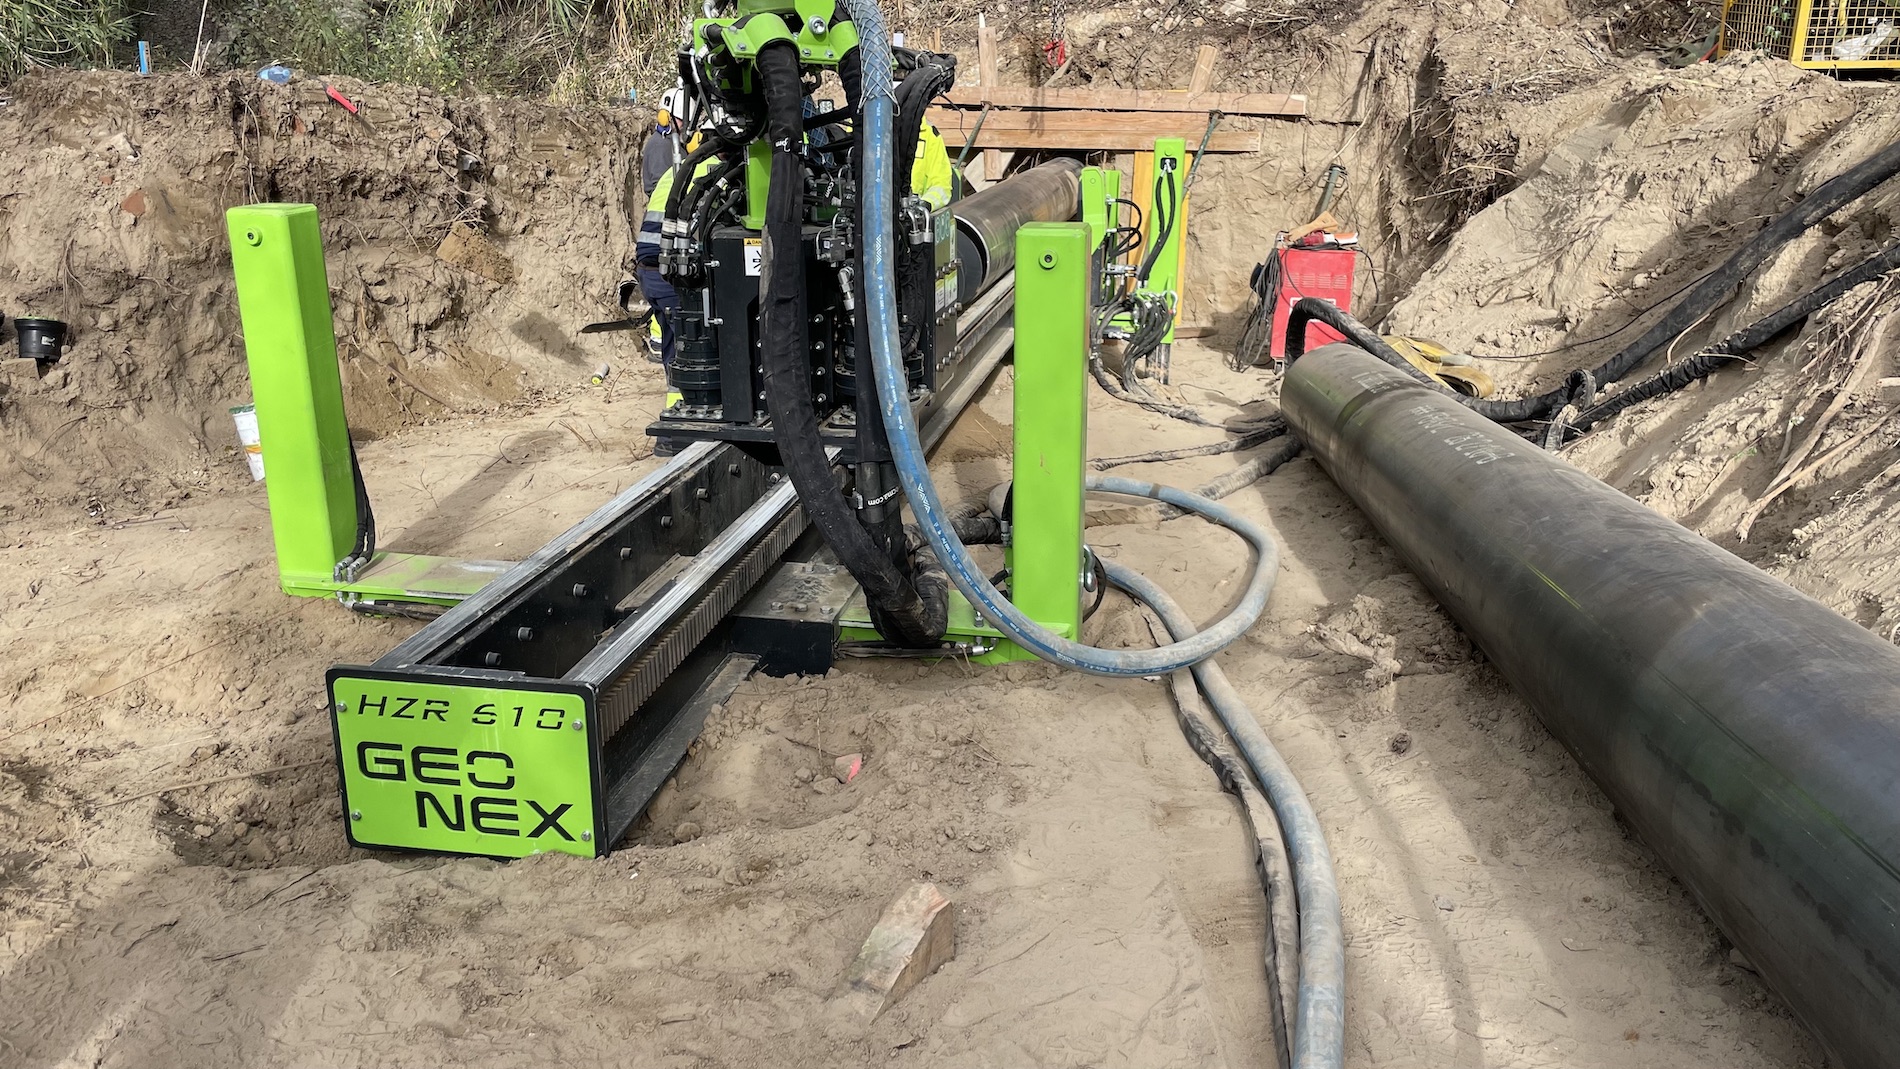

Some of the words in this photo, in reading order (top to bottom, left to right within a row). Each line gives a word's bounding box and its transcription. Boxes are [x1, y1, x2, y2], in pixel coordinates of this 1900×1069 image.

[357, 694, 450, 722] HZR
[471, 703, 566, 730] 610
[356, 741, 515, 790] GEO
[415, 790, 577, 842] NEX
